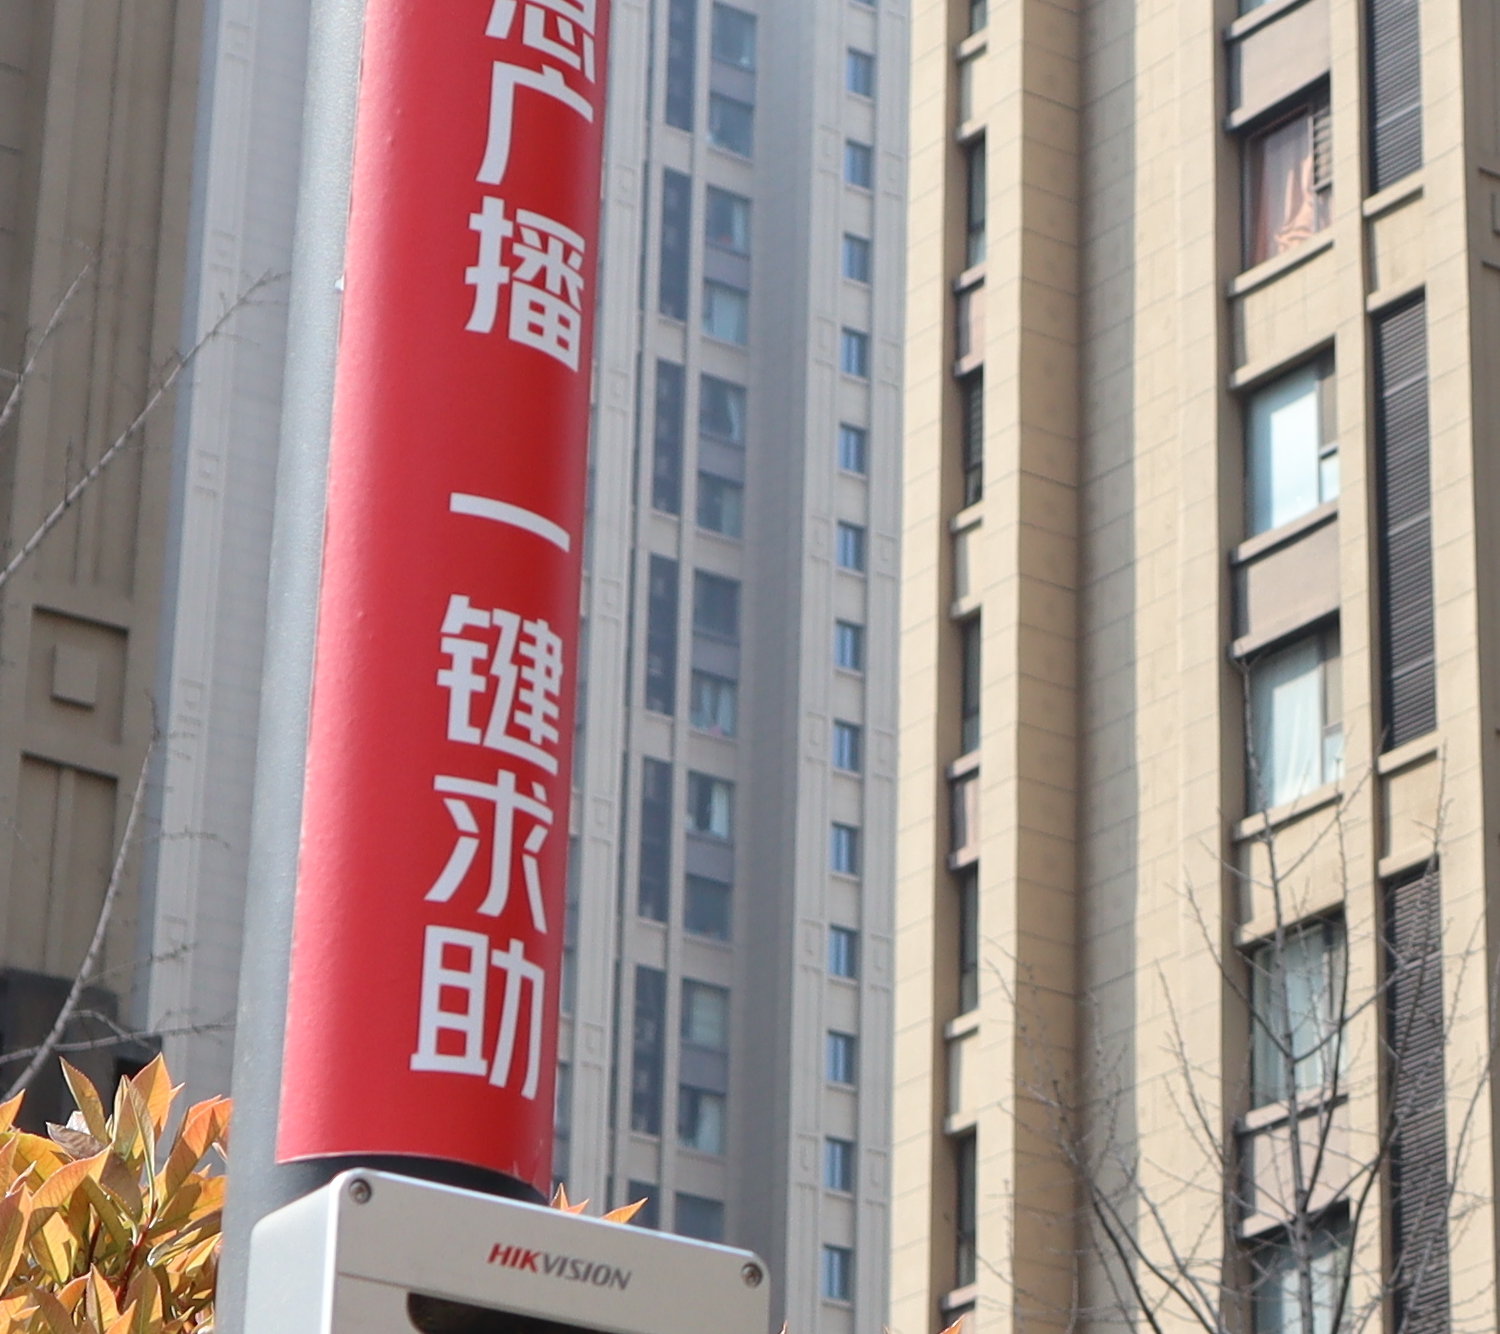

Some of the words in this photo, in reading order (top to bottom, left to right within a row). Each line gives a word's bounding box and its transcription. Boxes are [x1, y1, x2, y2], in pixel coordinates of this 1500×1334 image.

[410, 492, 570, 1100] 一键求助
[487, 1242, 632, 1291] HIKVISION
